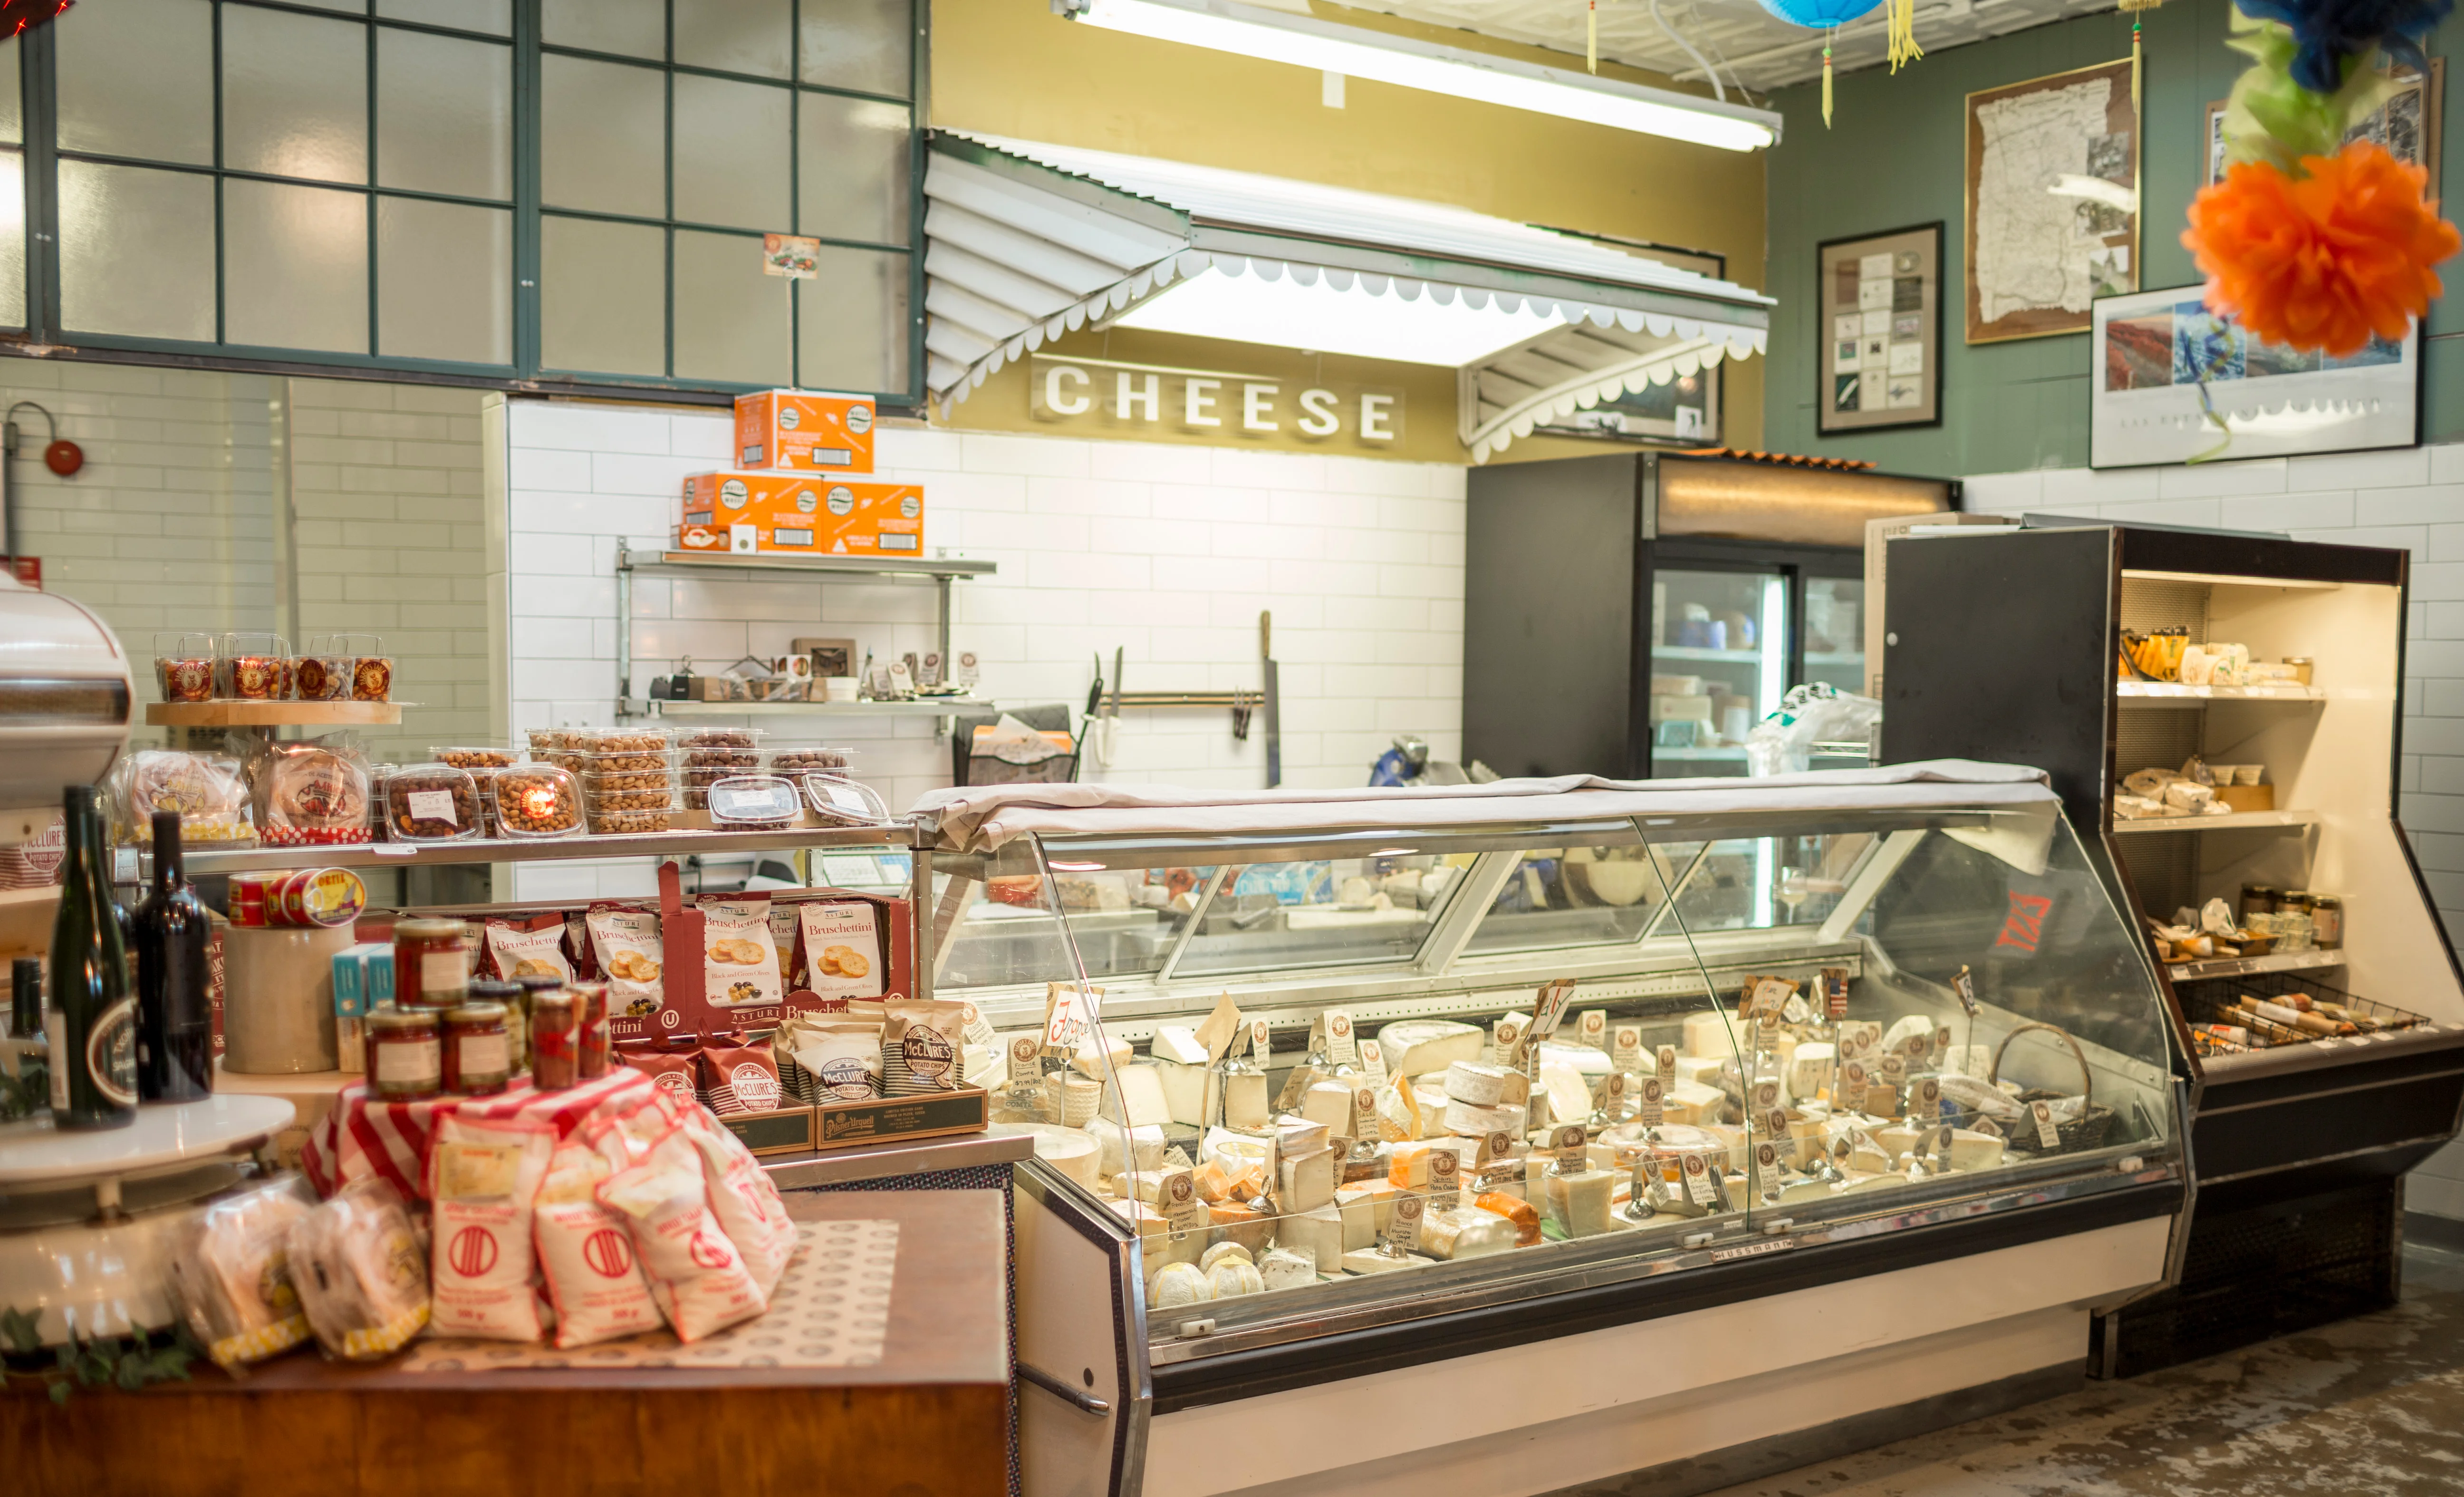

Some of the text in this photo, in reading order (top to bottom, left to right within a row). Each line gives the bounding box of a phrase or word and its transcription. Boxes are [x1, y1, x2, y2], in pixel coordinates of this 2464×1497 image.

[1045, 366, 1395, 440] CHEESE
[174, 663, 209, 682] PARKER'S TABLE
[237, 660, 271, 680] PARKER'S TABLE
[359, 664, 387, 686] PARKER'S TABLE
[825, 910, 854, 918] ASTURI
[704, 916, 767, 929] Bruschettini
[809, 922, 872, 935] Bruschettini
[597, 930, 659, 941] Bruschettini
[732, 1009, 780, 1022] ASTURI
[1051, 1000, 1092, 1045] France
[968, 1020, 982, 1032] France
[905, 1042, 951, 1059] McCLURE'S
[733, 1065, 770, 1080] BROOKLYN DETROIT
[823, 1071, 870, 1085] McCLURES
[733, 1082, 778, 1096] McCLURE'S
[826, 1119, 850, 1139] Pilsner
[849, 1115, 874, 1130] Urquell
[1396, 1234, 1411, 1242] Coupe
[1718, 1241, 1790, 1259] HUSSMANN
